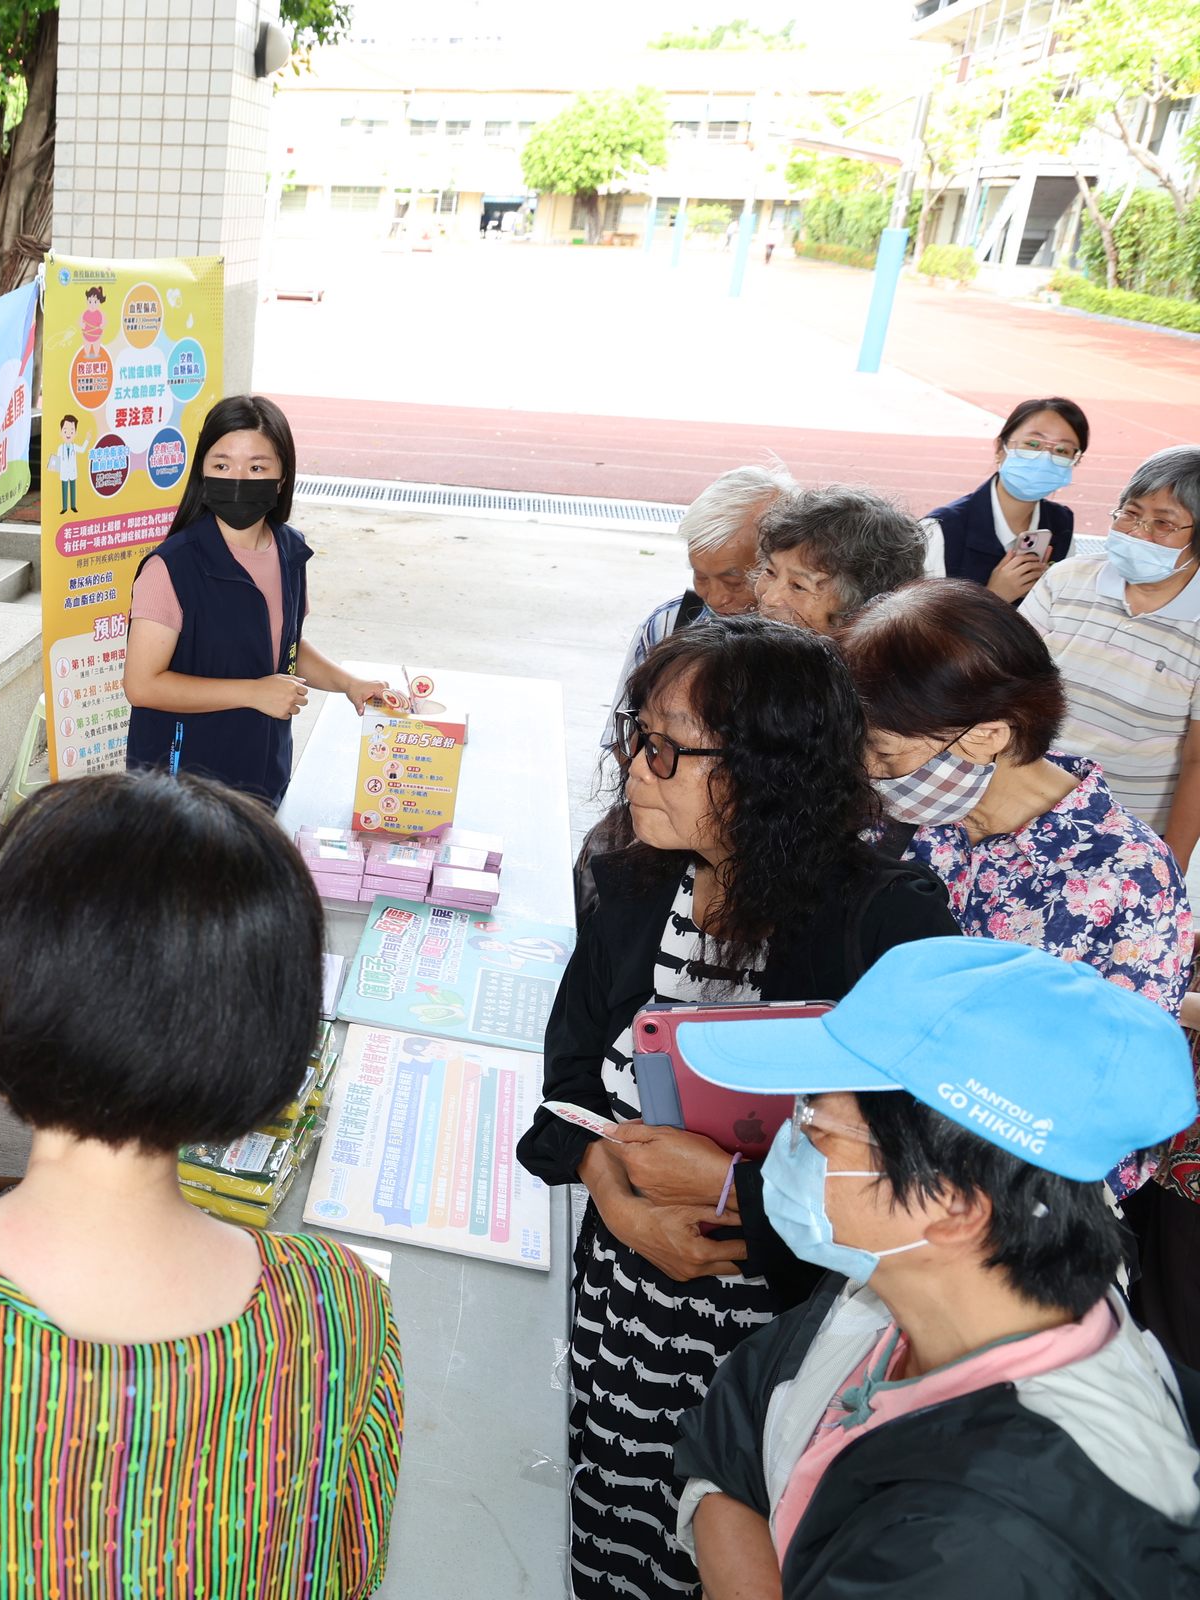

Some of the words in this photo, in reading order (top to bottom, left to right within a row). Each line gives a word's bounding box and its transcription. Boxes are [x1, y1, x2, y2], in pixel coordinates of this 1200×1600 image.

[69, 571, 113, 590] 糖尿病的6倍
[94, 614, 126, 641] 預防
[966, 1078, 1034, 1123] NANTOU
[938, 1083, 968, 1109] GO
[968, 1104, 1047, 1155] HIKING
